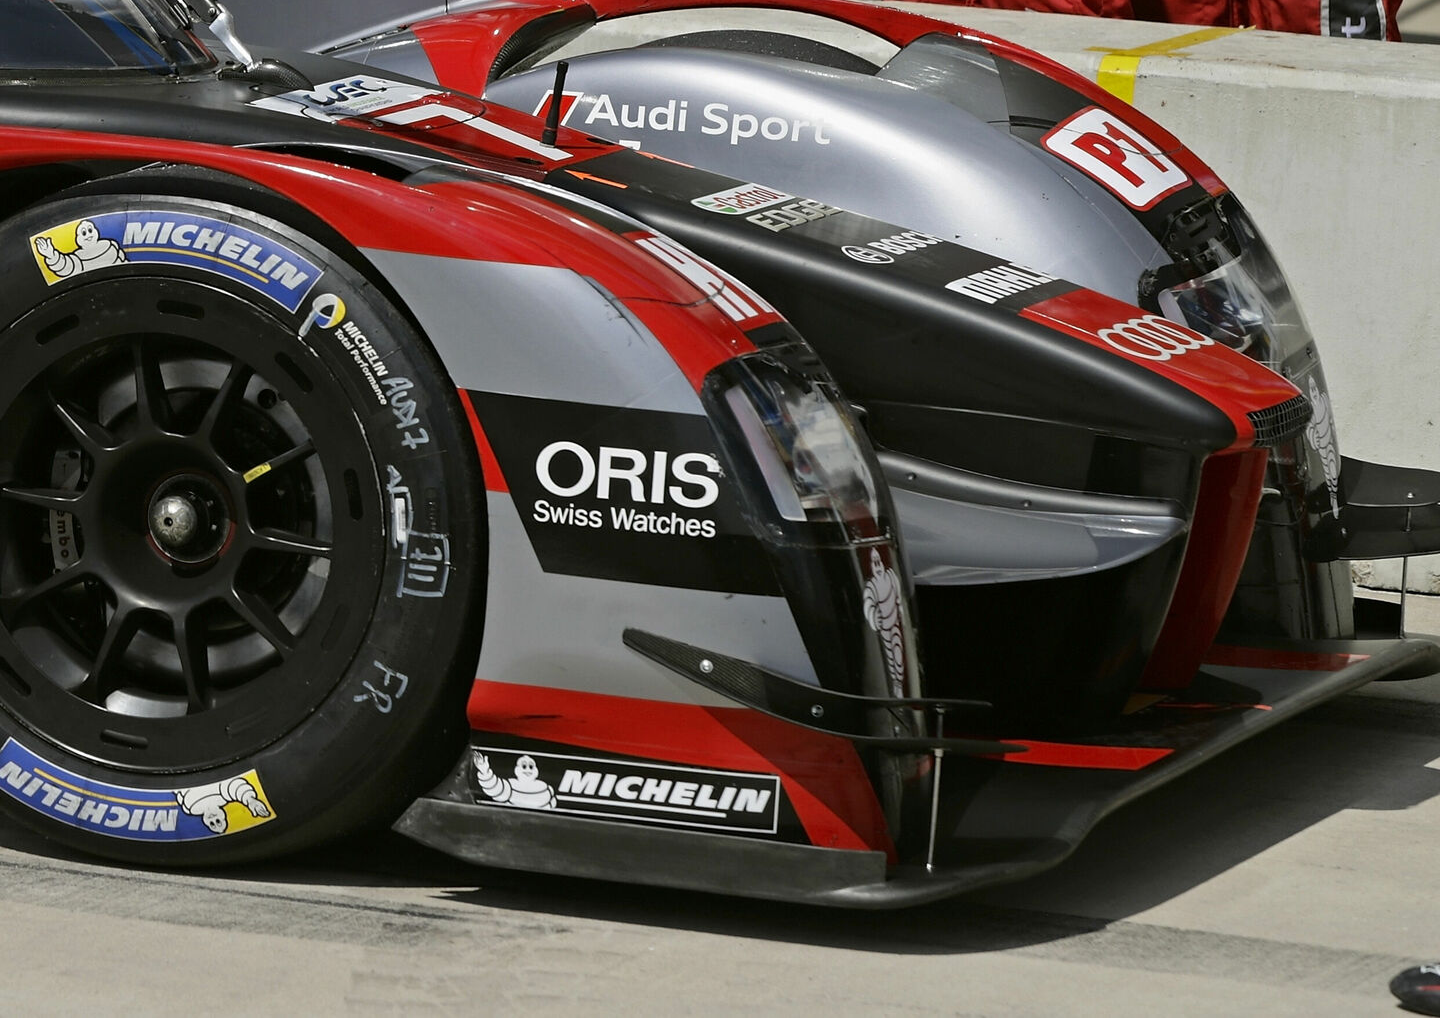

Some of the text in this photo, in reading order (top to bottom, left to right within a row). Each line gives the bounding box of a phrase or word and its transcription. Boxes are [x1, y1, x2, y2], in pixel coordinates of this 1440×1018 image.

[584, 93, 832, 145] Audi Sport
[1071, 121, 1169, 188] P1
[713, 186, 786, 210] Castrol
[745, 198, 843, 233] EDGE
[123, 220, 309, 291] MICHELIN
[334, 328, 387, 405] Total Performance
[342, 320, 389, 377] MICHELIN
[534, 439, 721, 510] ORIS
[532, 498, 717, 539] Swiss Watches
[558, 769, 772, 814] MICHELIN
